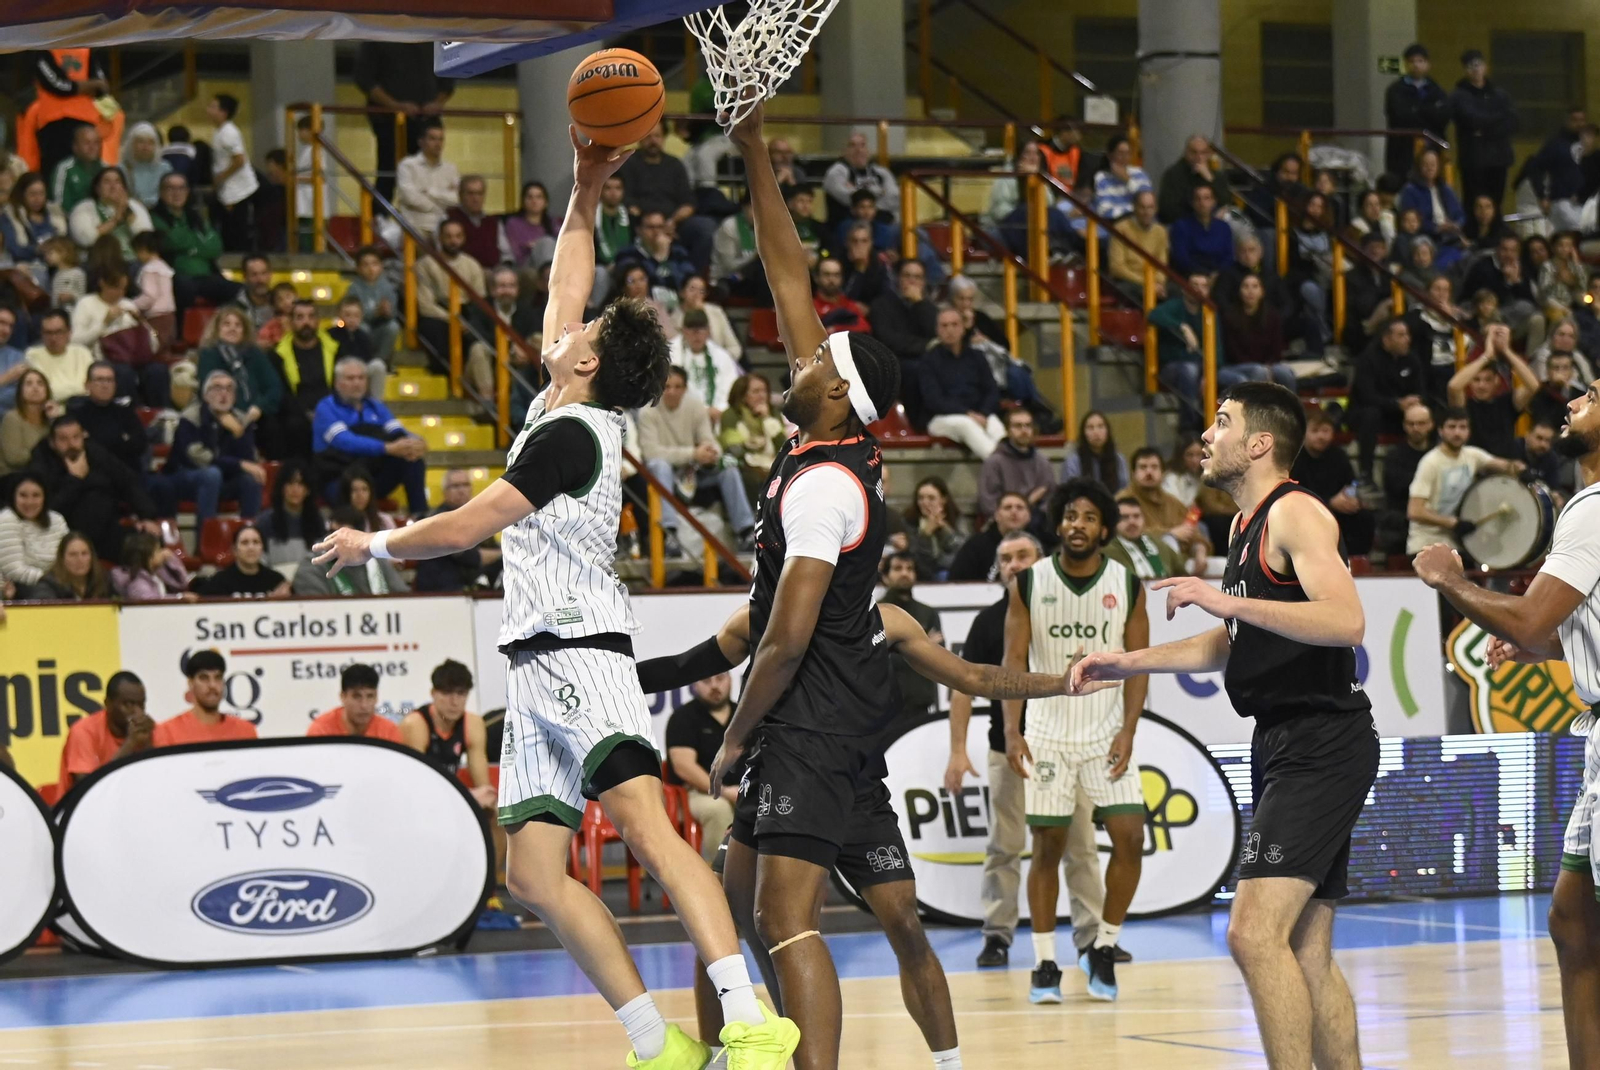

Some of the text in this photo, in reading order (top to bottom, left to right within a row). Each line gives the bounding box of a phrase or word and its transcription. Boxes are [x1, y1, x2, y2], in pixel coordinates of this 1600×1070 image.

[576, 62, 639, 84] Wilson
[196, 617, 245, 640] San
[254, 614, 338, 639] Carlos
[359, 612, 378, 635] &
[386, 612, 401, 635] II
[1049, 621, 1097, 639] coto
[905, 786, 989, 840] PiE
[216, 817, 335, 850] TYSA
[229, 879, 337, 924] Ford
